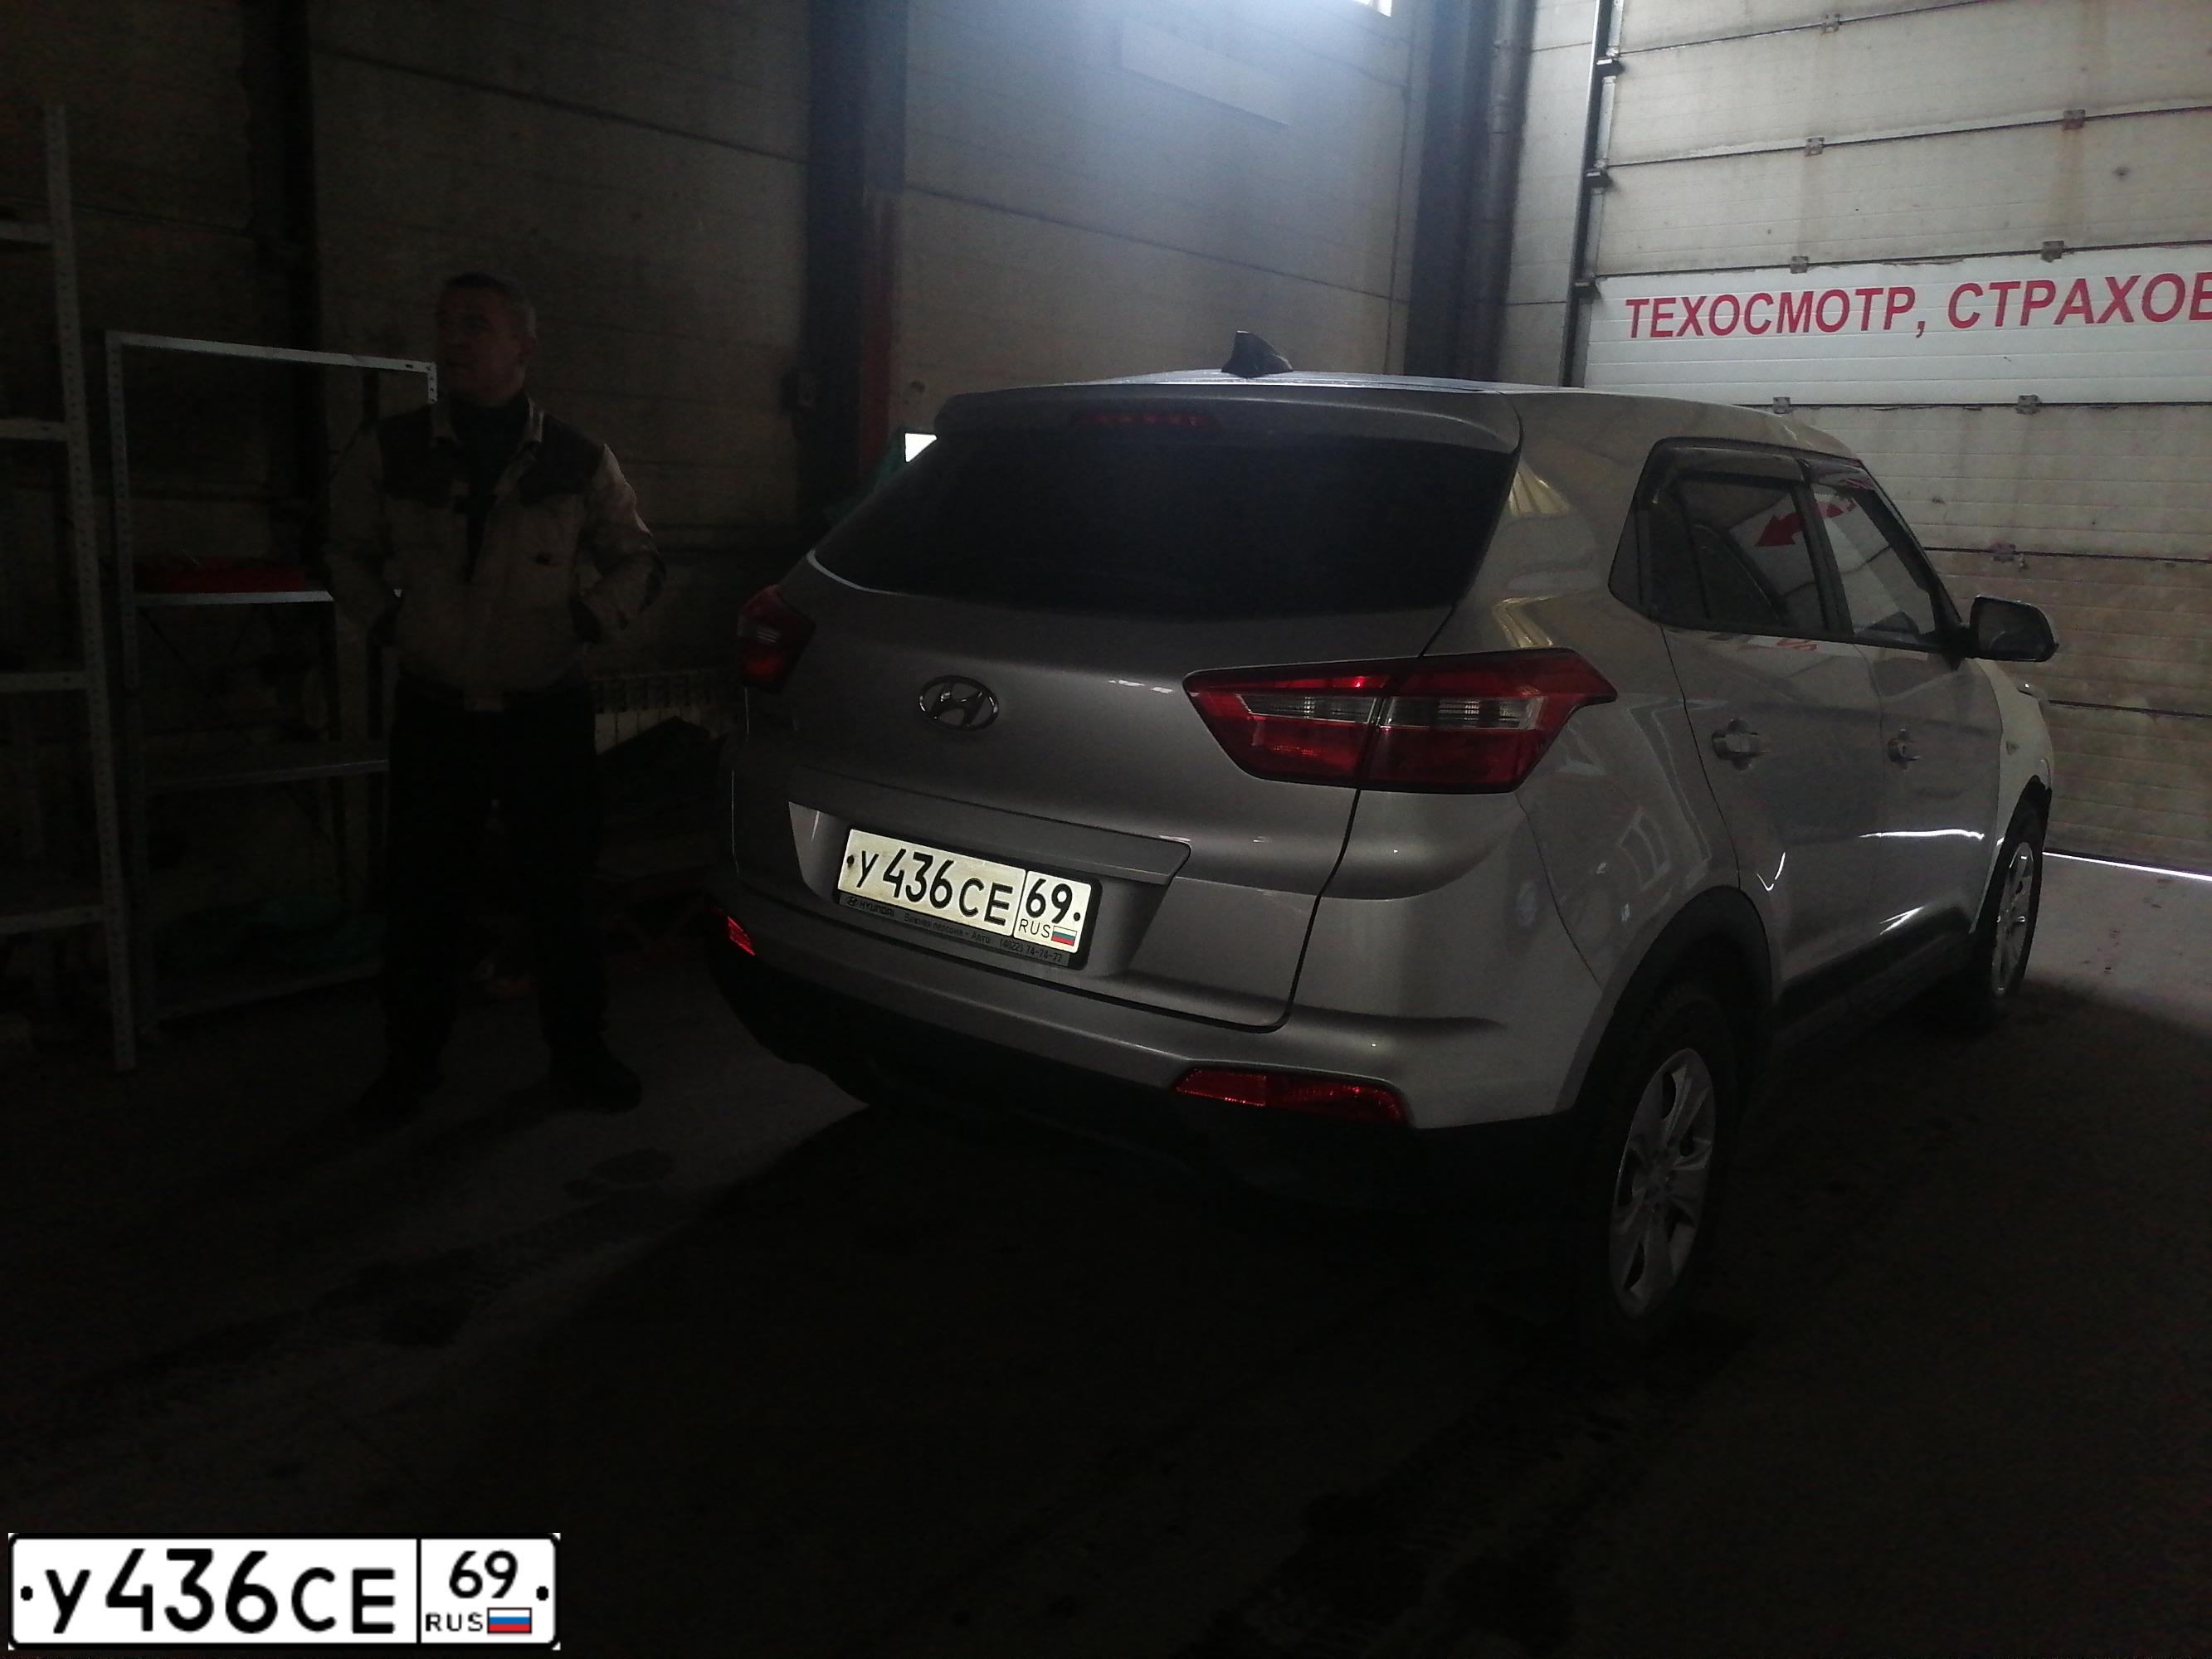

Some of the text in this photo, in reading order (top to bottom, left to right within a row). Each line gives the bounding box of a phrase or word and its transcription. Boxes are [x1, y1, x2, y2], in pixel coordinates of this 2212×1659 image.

[1625, 285, 1926, 339] ТЕХОСМОТР,
[1025, 878, 1074, 924] 69
[1018, 917, 1051, 939] RUS
